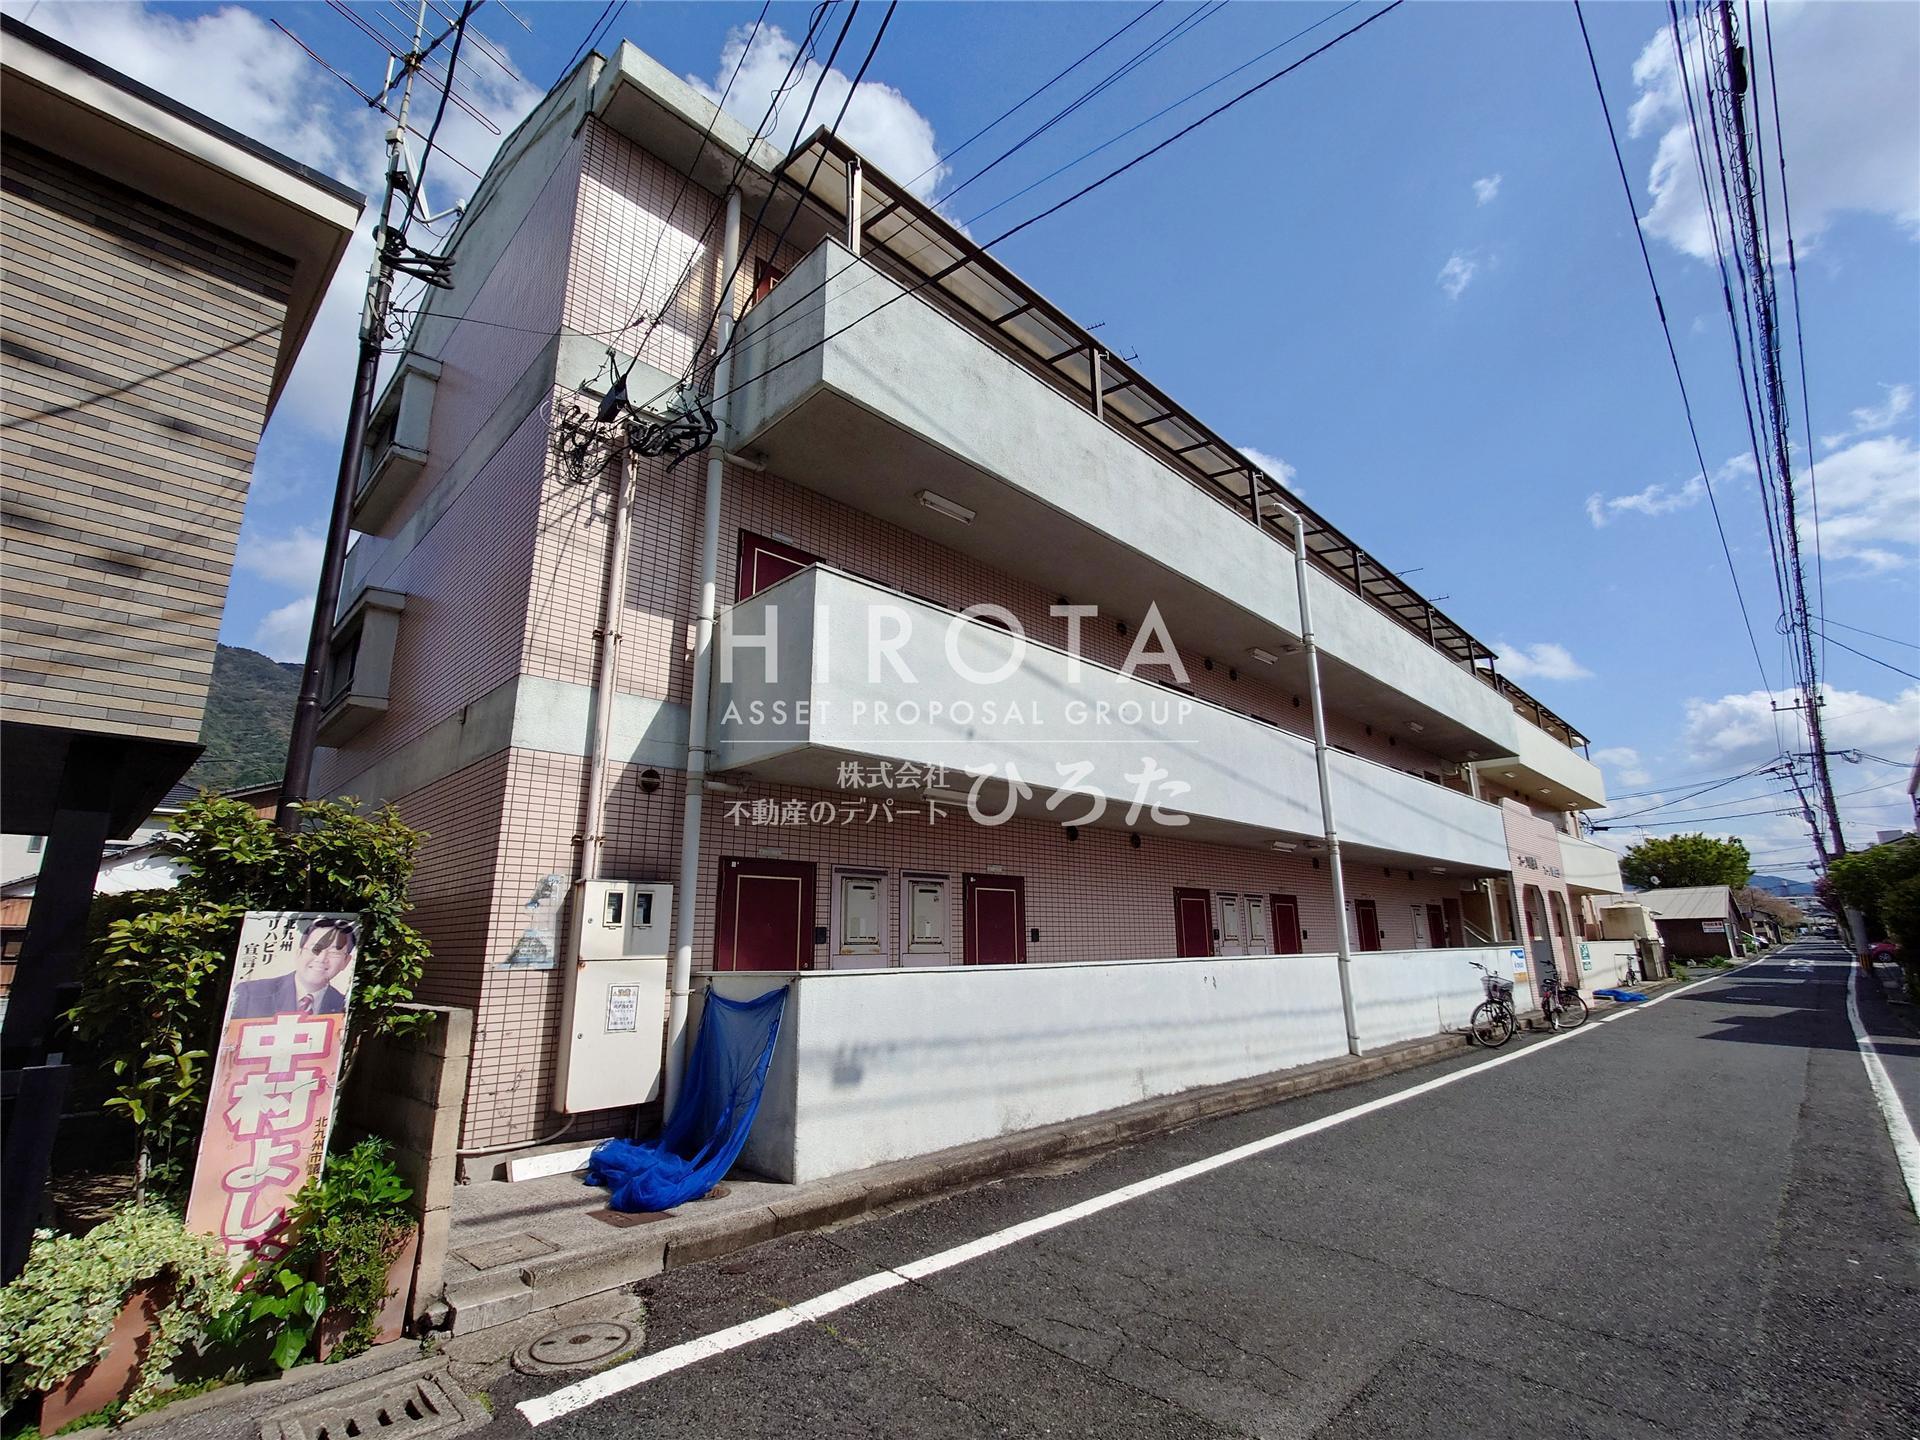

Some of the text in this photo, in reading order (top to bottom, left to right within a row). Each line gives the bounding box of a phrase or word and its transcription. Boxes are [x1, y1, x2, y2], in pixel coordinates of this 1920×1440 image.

[262, 919, 279, 966] リハビリ
[280, 919, 296, 952] 北九州
[305, 1116, 328, 1183] 北九州市議
